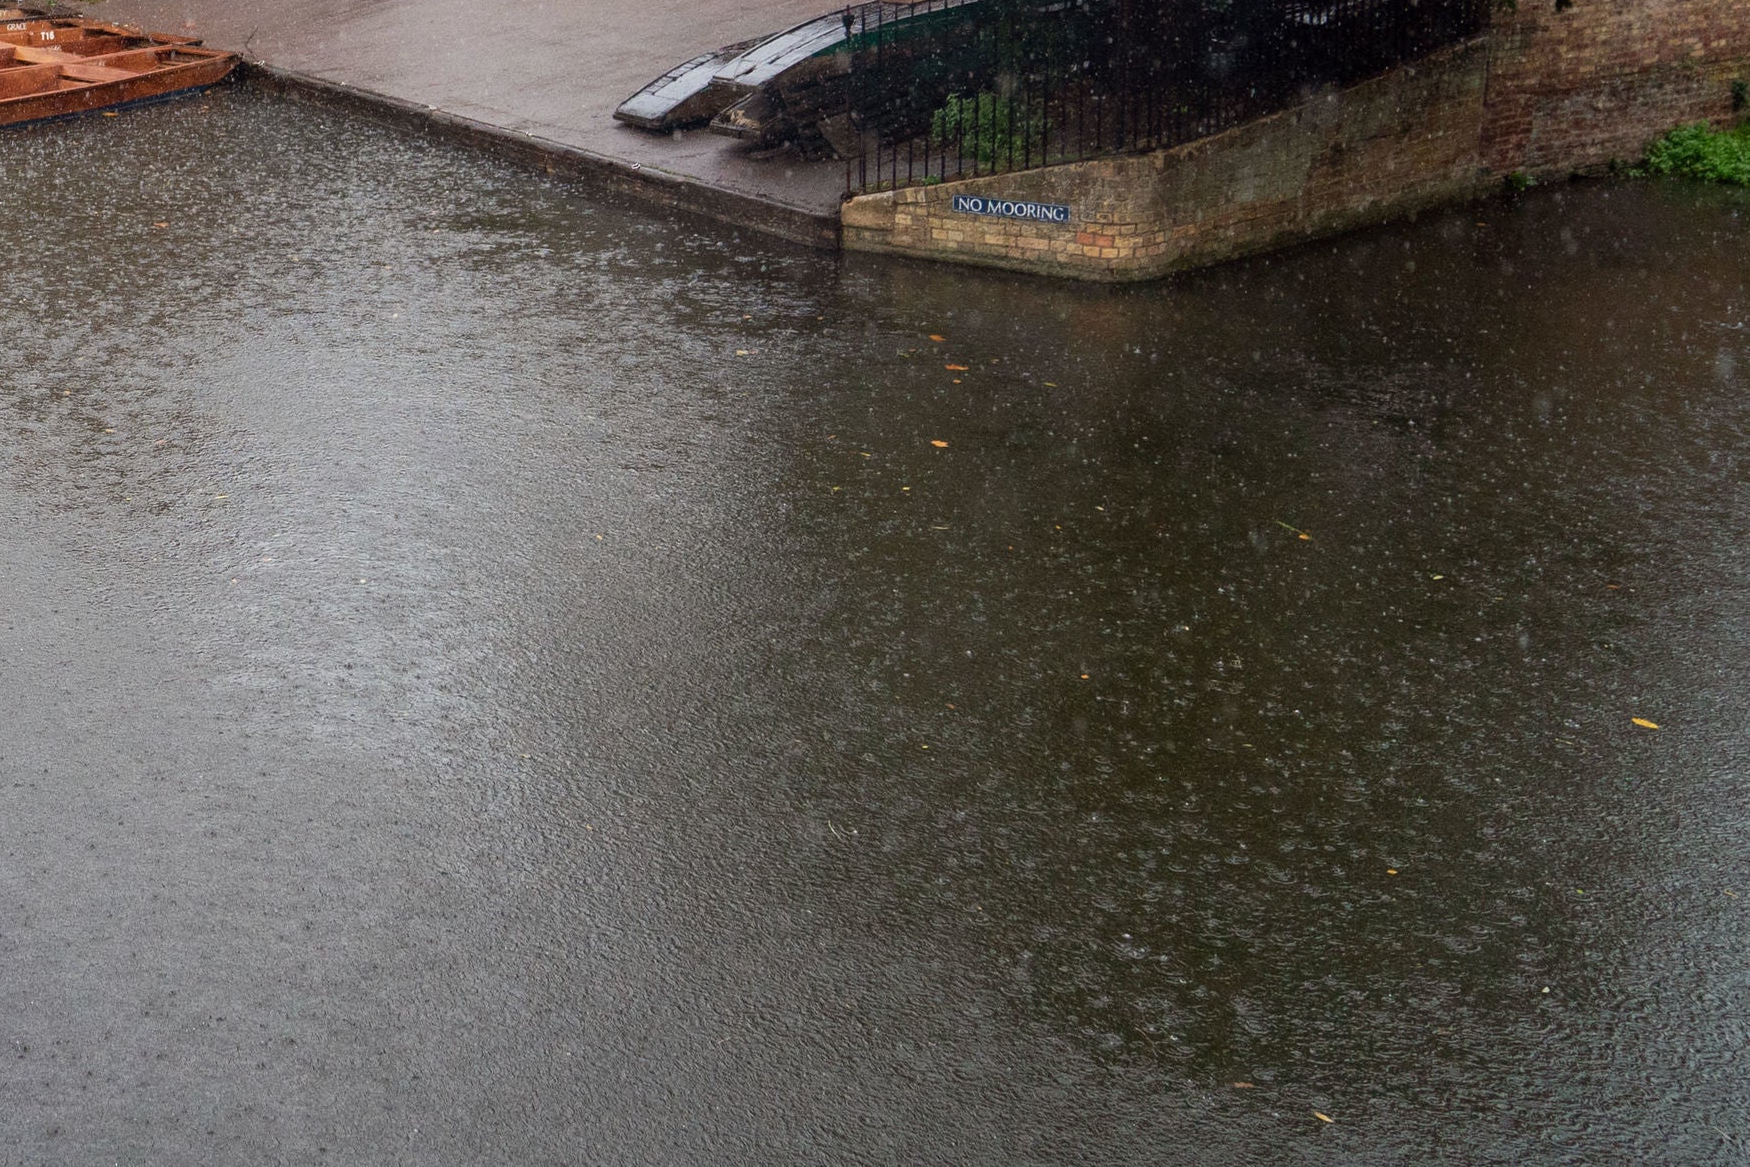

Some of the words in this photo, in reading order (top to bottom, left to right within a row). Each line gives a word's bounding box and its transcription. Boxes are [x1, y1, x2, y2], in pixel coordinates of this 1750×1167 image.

[7, 23, 27, 31] GRACE
[958, 197, 983, 212] NO
[986, 200, 1064, 221] MOORING
